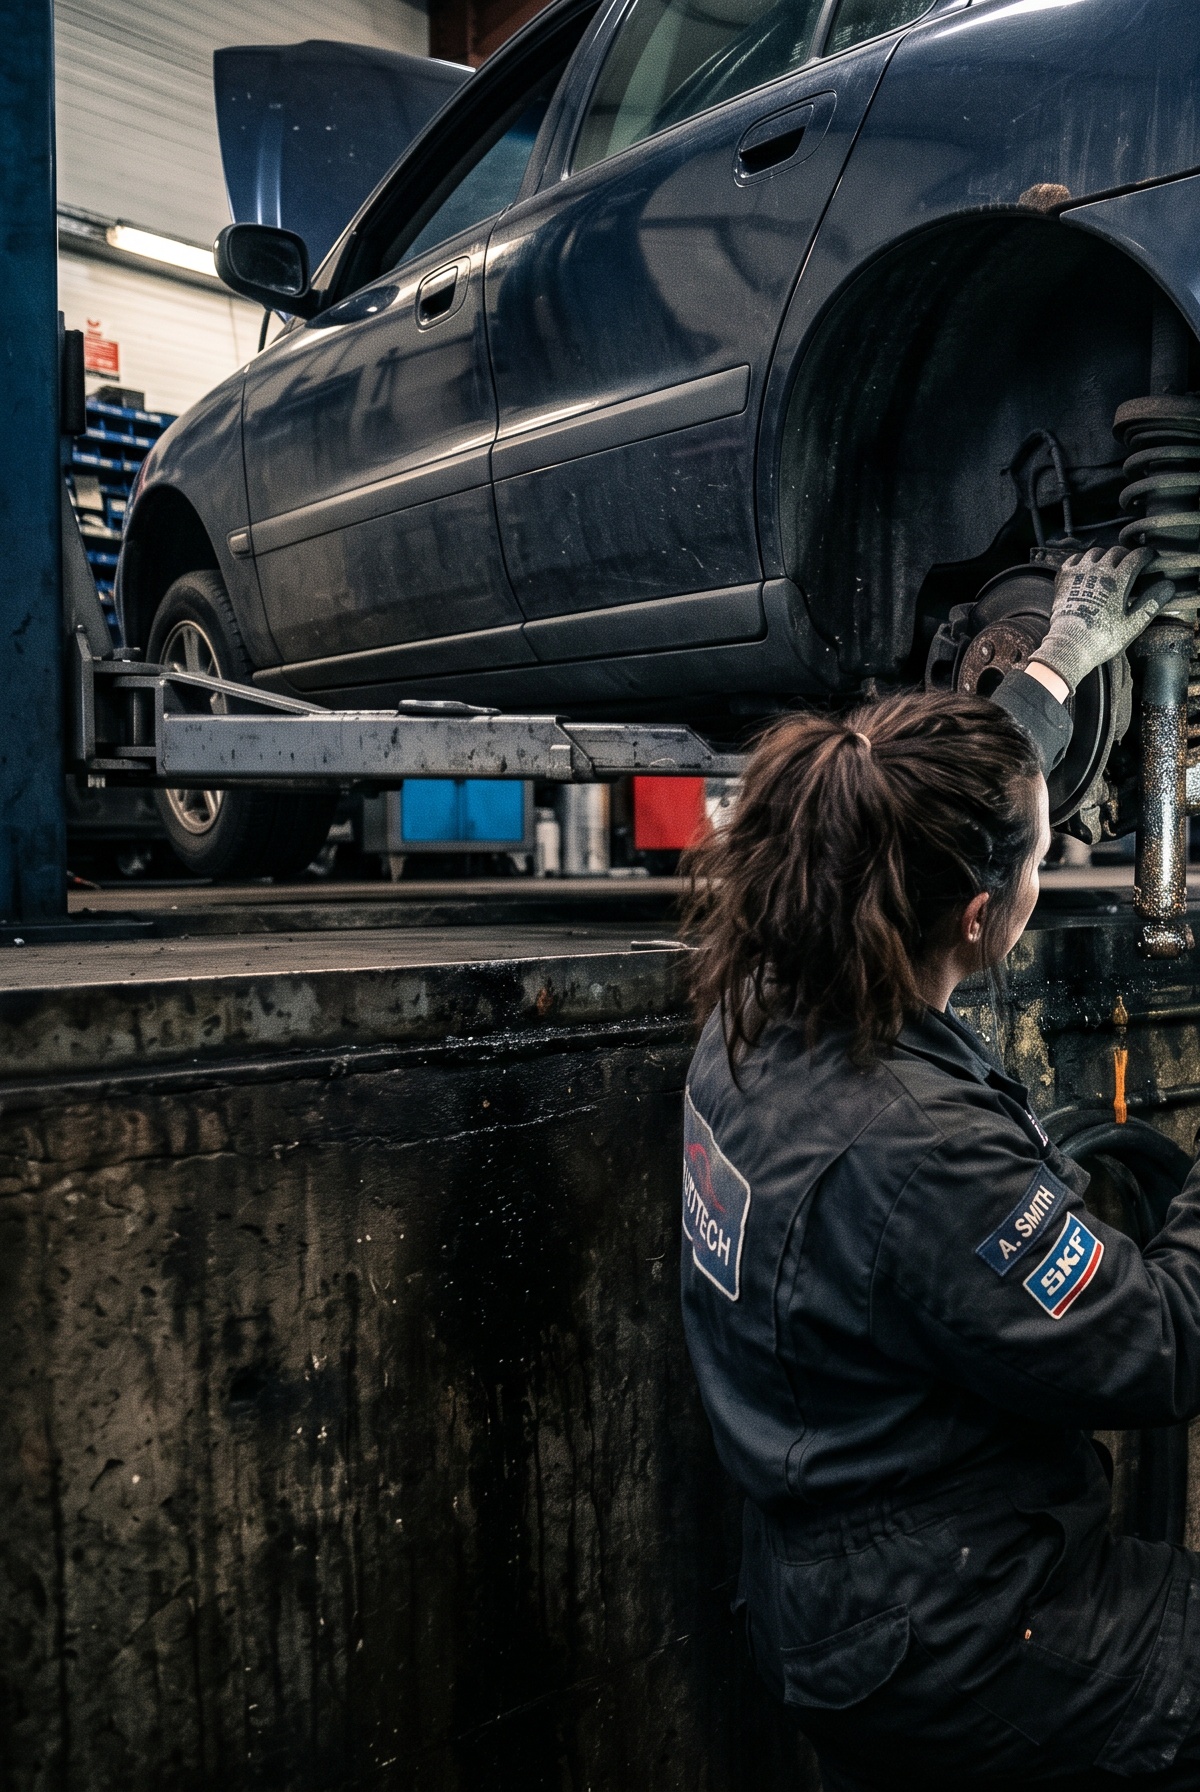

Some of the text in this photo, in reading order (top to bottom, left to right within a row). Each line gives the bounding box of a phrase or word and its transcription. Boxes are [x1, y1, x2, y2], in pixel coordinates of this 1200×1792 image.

[998, 1238, 1022, 1260] A.
[1014, 1184, 1056, 1238] SMITH
[1040, 1226, 1086, 1297] SKF
